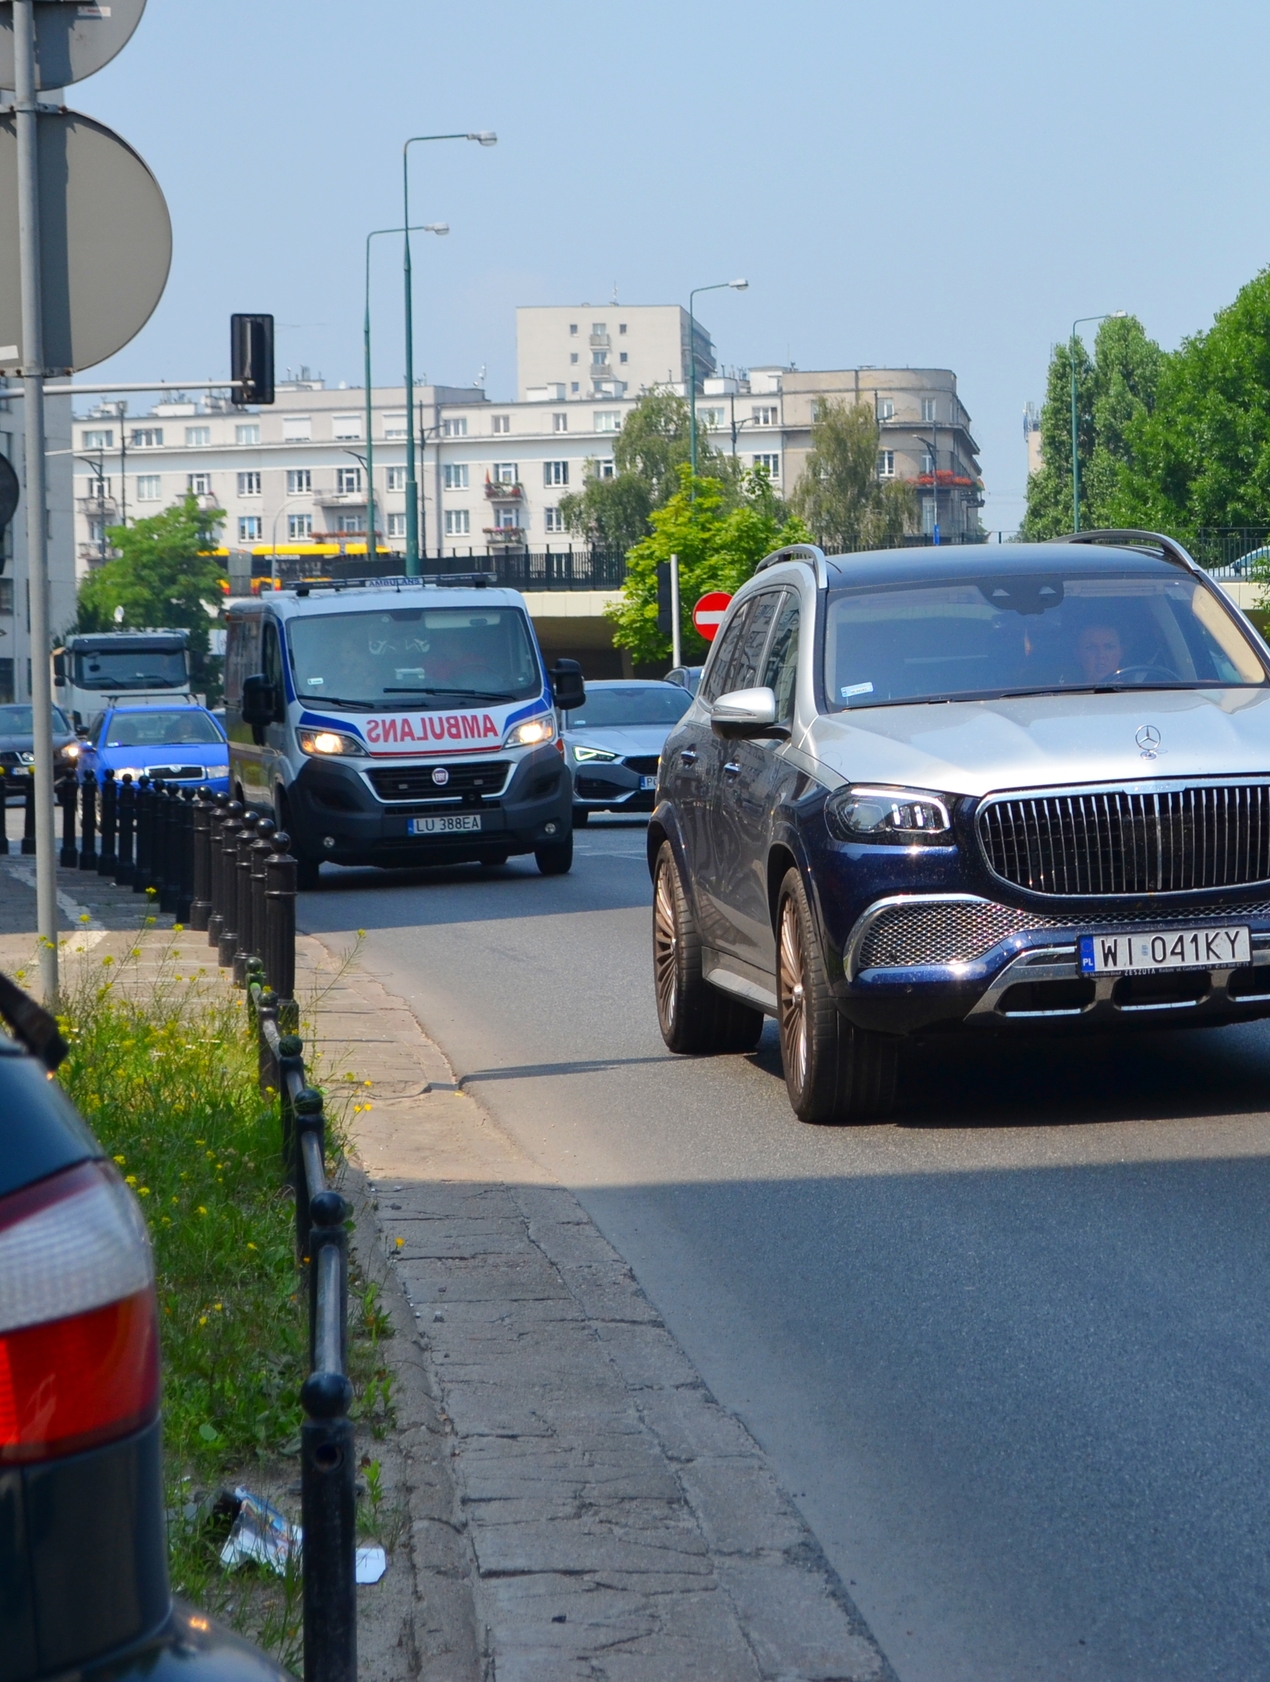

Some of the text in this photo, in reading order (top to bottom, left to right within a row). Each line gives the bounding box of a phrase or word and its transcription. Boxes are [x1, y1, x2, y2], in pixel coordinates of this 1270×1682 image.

[416, 816, 479, 832] LU 388EA
[1101, 930, 1241, 967] WI 041KY
[1082, 957, 1094, 966] PL
[1124, 968, 1156, 976] ZESZUTA
